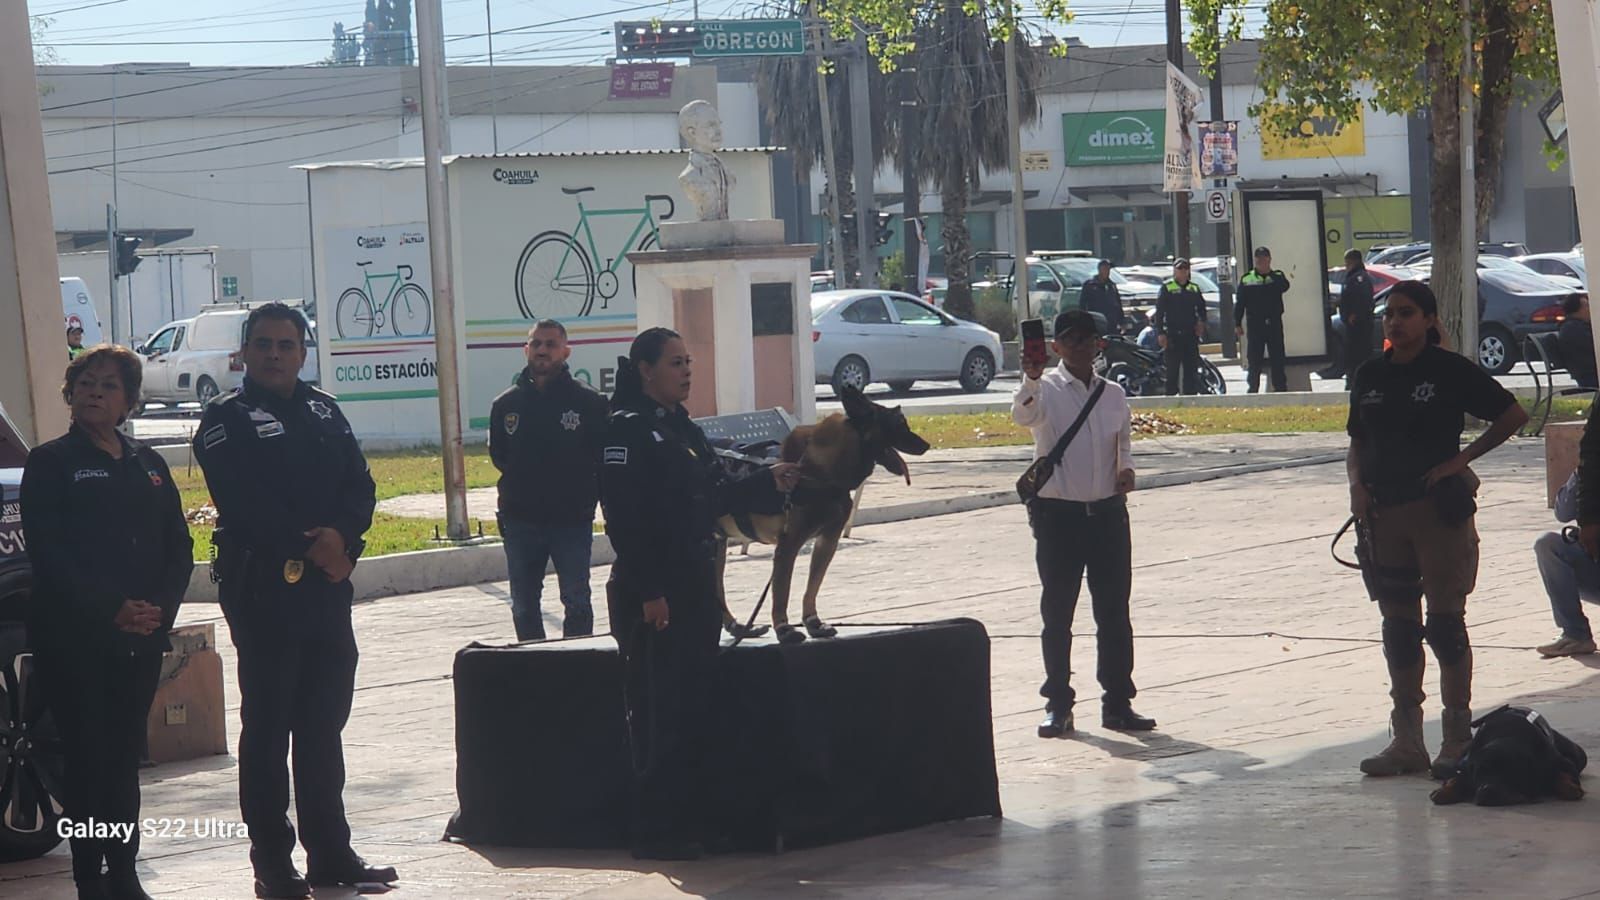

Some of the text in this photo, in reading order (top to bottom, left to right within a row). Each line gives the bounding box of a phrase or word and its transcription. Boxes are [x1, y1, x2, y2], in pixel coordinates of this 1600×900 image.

[699, 24, 724, 32] CALLE
[703, 31, 794, 50] OBREGON
[1088, 129, 1154, 147] dimex
[493, 168, 539, 181] COAHUILA
[336, 358, 438, 381] CICLO ESTACIÓN
